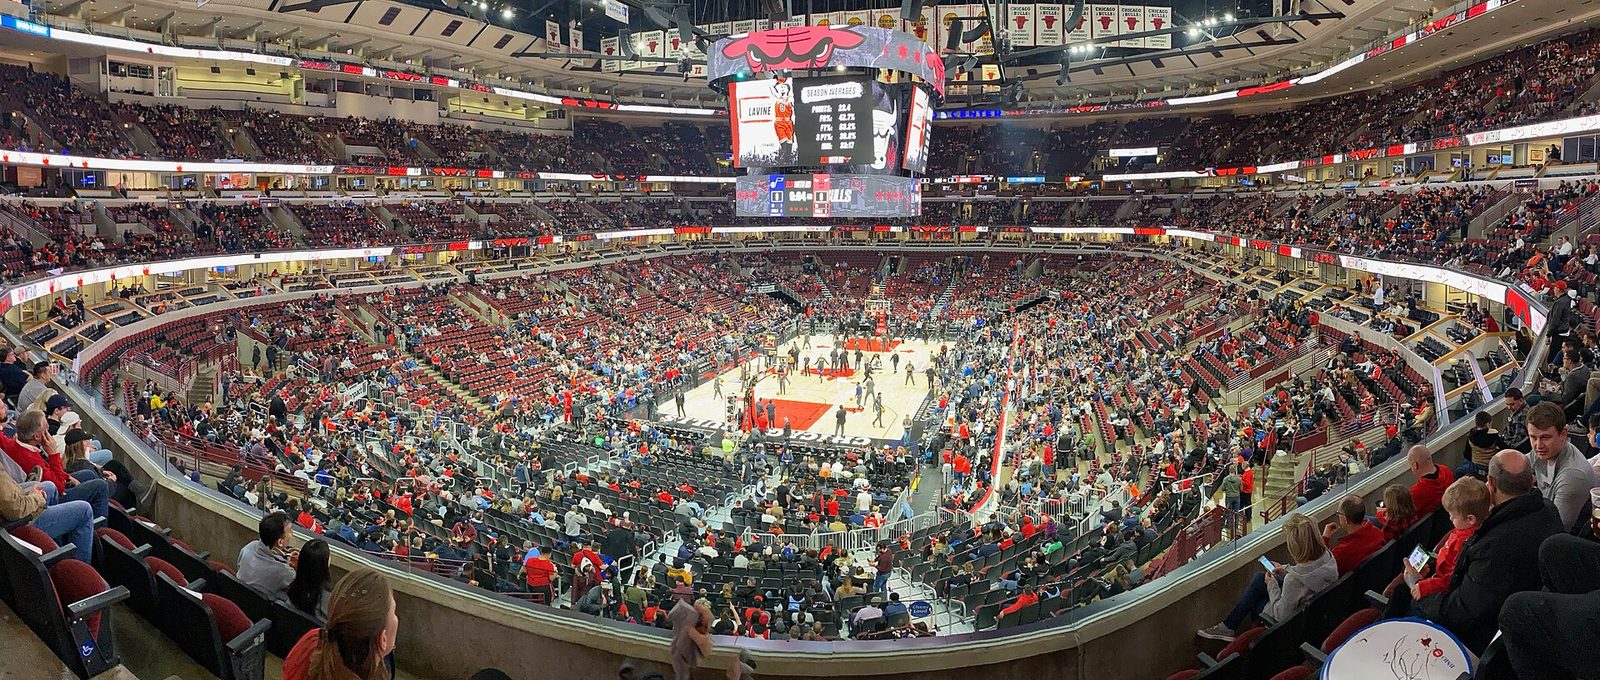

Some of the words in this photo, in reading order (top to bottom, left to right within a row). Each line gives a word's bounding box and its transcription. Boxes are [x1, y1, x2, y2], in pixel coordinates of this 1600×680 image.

[807, 88, 828, 97] SEASON
[829, 87, 856, 96] AVERAGES
[749, 106, 771, 116] LAVINE
[951, 109, 1001, 119] CENTER
[829, 189, 852, 202] ULLS
[764, 428, 871, 445] CHICAG
